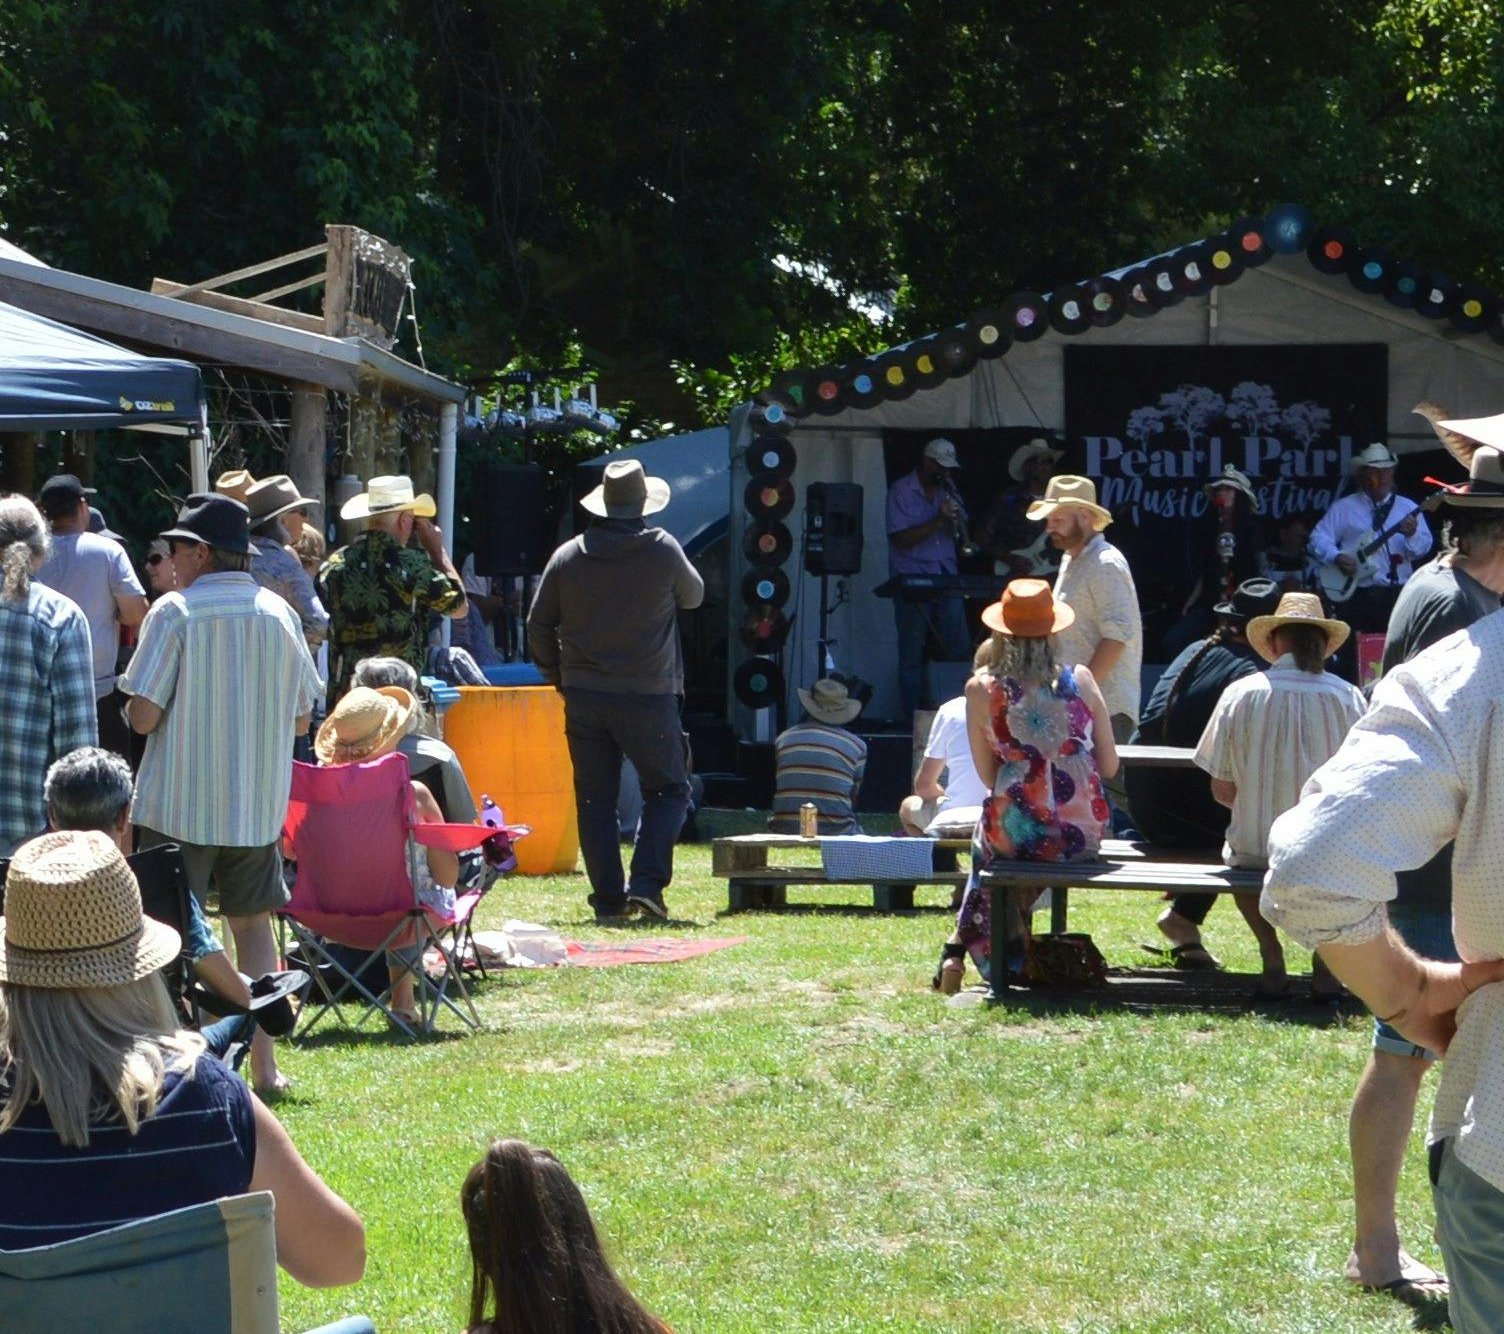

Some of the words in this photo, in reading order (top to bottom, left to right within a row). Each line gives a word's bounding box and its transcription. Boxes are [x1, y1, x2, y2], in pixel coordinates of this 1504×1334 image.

[1084, 435, 1223, 477] Pearl
[1099, 473, 1208, 527] Music
[1256, 475, 1350, 520] stival
